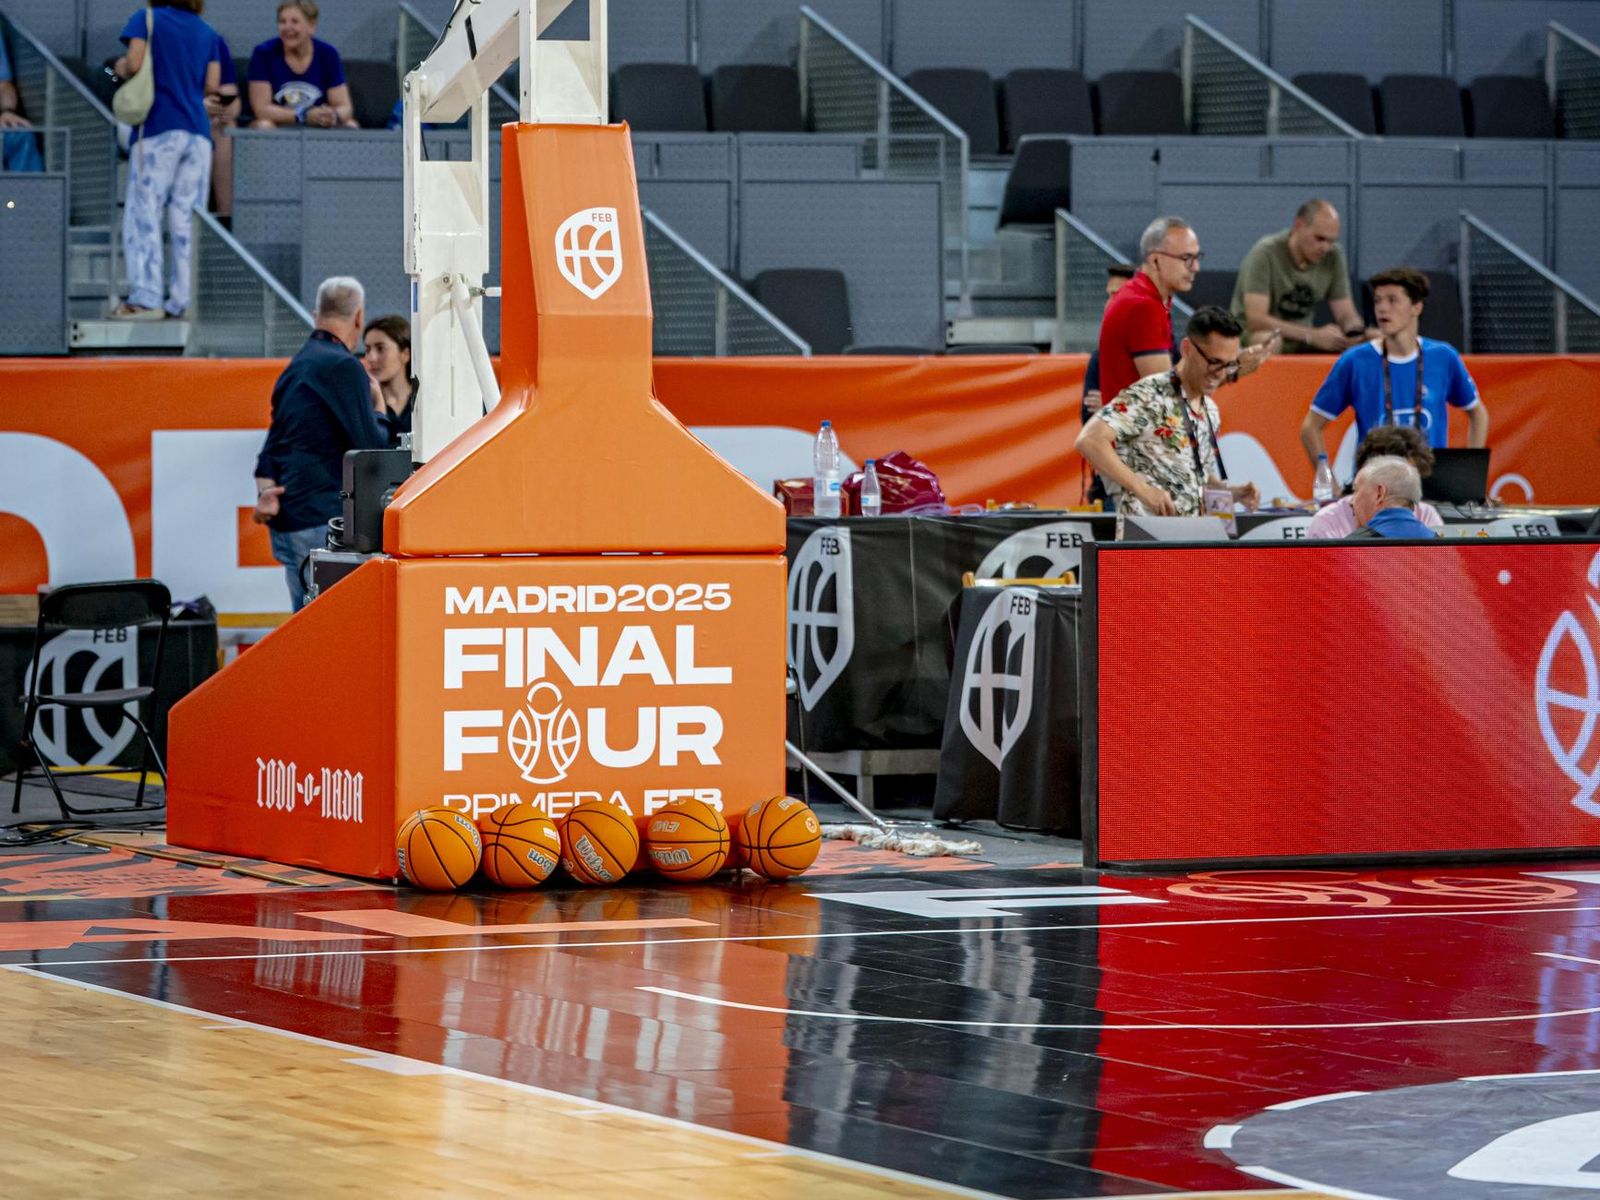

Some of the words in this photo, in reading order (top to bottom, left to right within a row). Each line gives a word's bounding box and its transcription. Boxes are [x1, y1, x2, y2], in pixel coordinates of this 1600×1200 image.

[591, 212, 613, 223] FEB
[1045, 532, 1084, 549] FEB
[1282, 527, 1306, 540] FE
[820, 536, 841, 555] FEB
[443, 582, 732, 615] MADRID2025
[1010, 595, 1031, 615] FEB
[92, 627, 128, 645] FEB
[443, 624, 733, 689] FINAL
